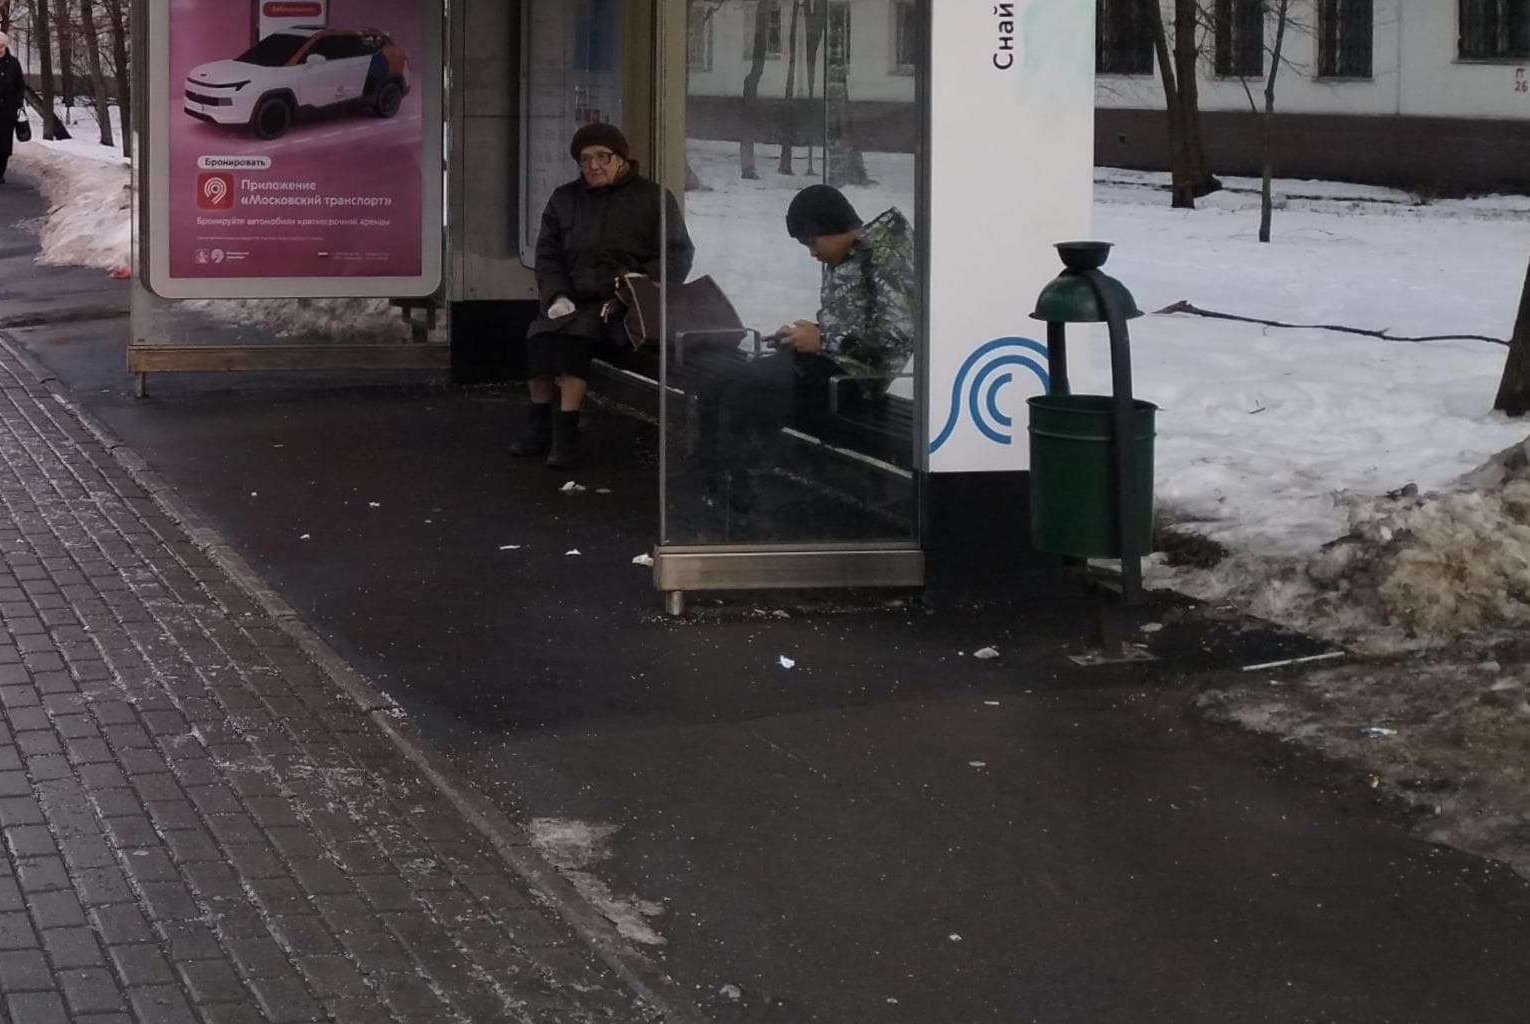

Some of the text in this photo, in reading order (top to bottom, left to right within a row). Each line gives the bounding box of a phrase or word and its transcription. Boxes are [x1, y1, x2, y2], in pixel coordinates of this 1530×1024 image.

[205, 157, 266, 168] Бронировать
[241, 179, 316, 192] Приложение
[241, 194, 391, 208] «Московский транспорт»
